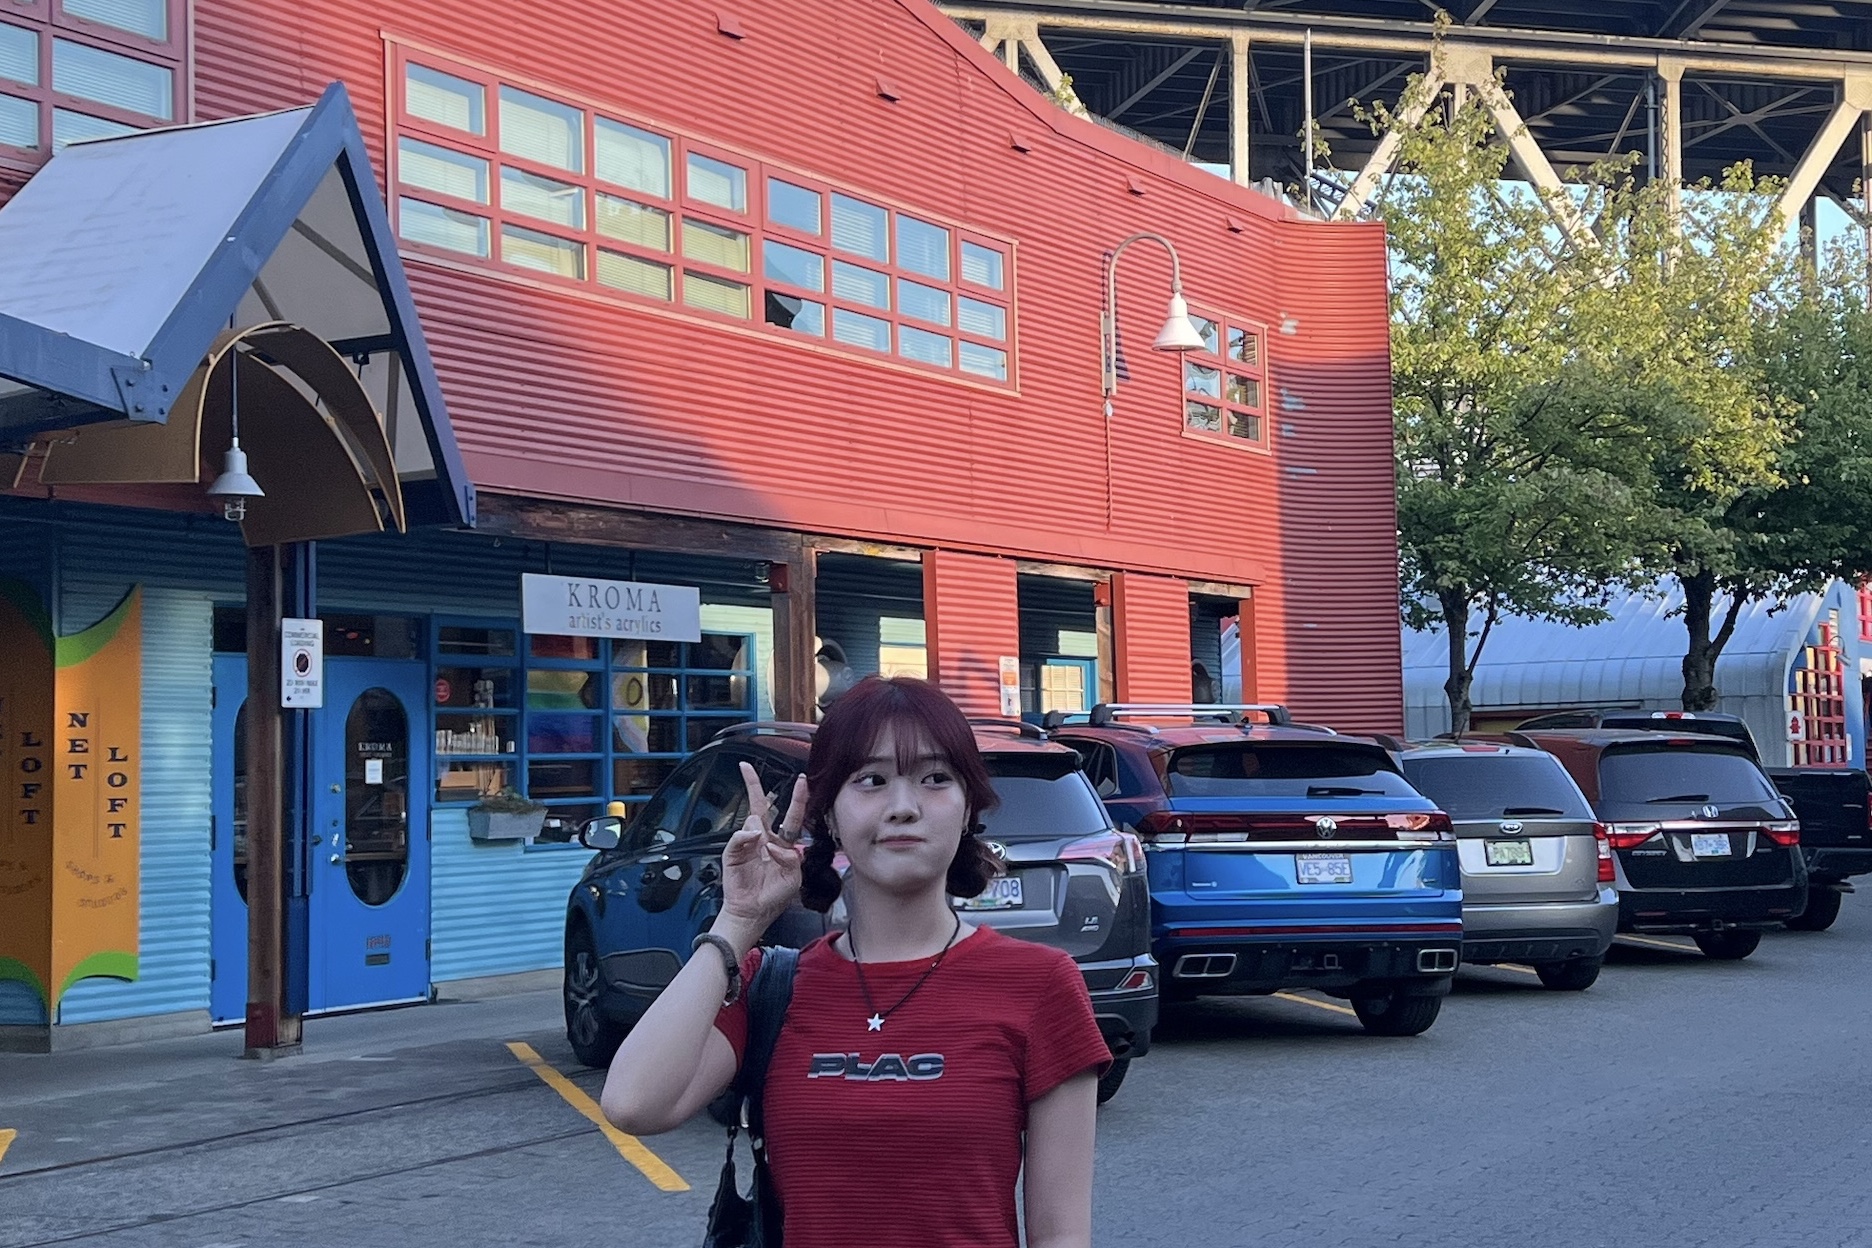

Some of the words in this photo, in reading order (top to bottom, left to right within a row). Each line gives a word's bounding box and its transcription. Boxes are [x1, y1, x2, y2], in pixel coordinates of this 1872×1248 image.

[567, 582, 662, 613] KROMA
[568, 612, 612, 632] artist's
[616, 616, 662, 635] acrylics
[66, 712, 90, 780] NET
[20, 731, 43, 825] LOFT
[106, 746, 129, 839] LOFT
[806, 1052, 945, 1082] PLAC
